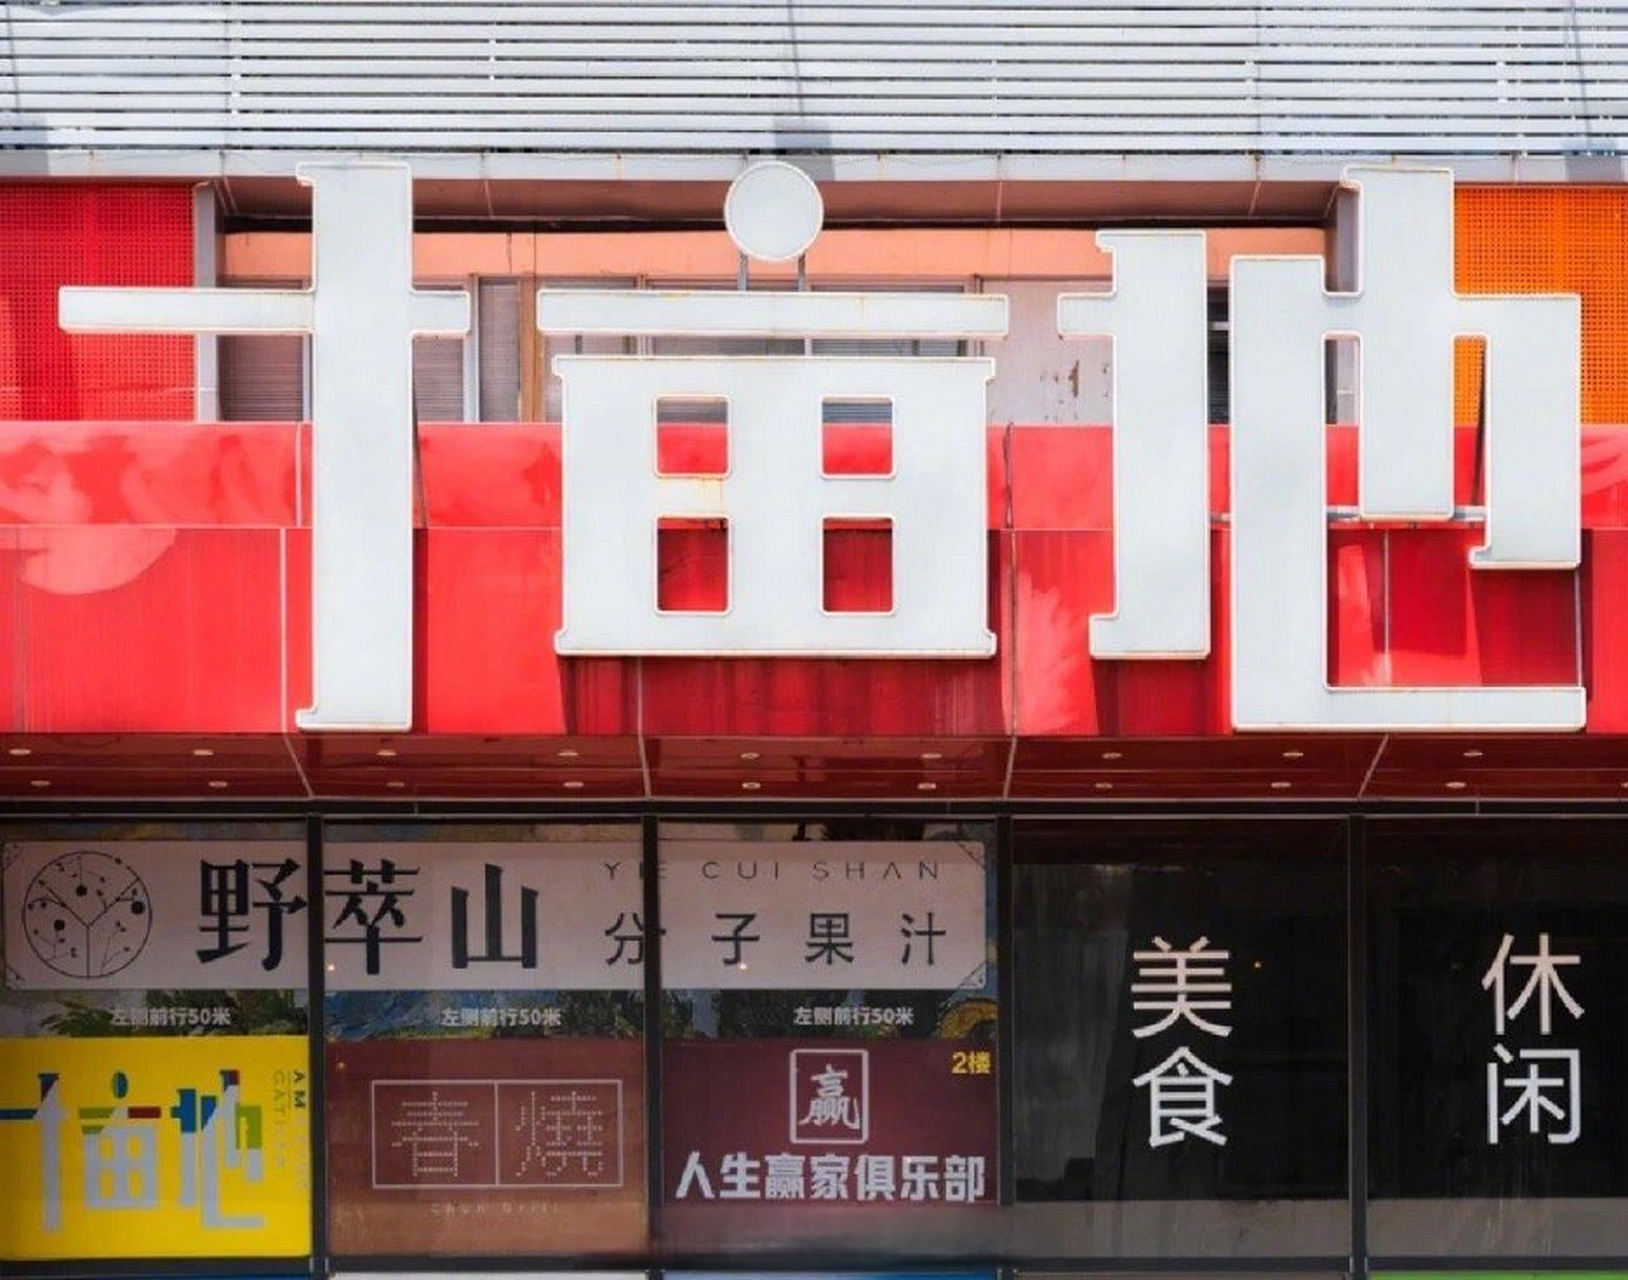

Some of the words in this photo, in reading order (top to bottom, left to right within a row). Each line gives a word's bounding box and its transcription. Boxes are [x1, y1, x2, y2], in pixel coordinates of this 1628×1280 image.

[701, 861, 779, 880] CUI
[812, 861, 939, 881] SHAN
[196, 858, 539, 975] 野萃山
[604, 911, 947, 967] 分子果汁
[110, 1006, 231, 1027] 左侧前行50米
[440, 1007, 562, 1027] 左侧前行50米
[793, 1006, 914, 1026] 左侧前行50米
[1131, 936, 1232, 1147] 美食
[1481, 933, 1585, 1144] 休闲
[952, 1051, 991, 1075] 2楼
[675, 1151, 986, 1202] 人生赢家俱乐部
